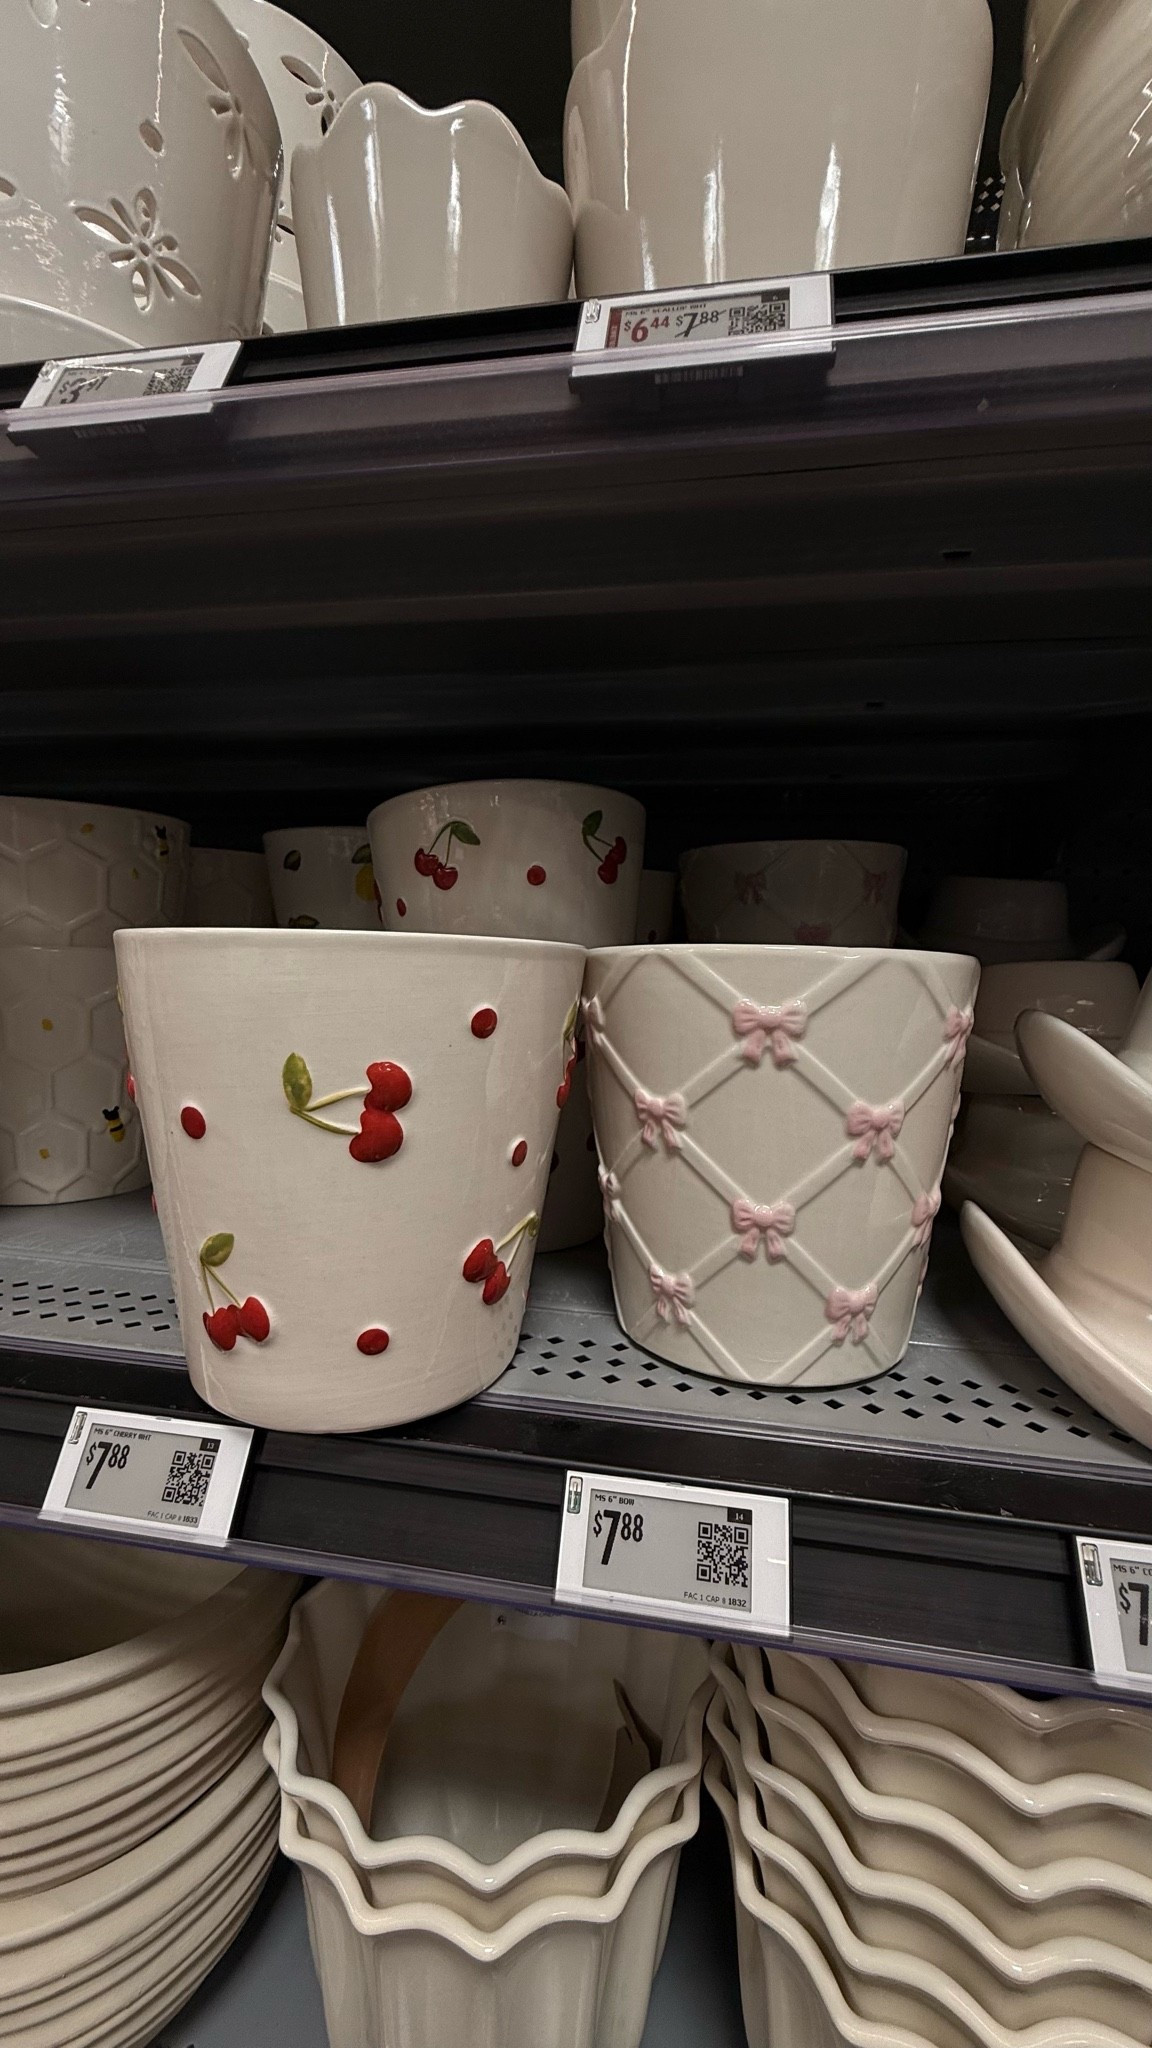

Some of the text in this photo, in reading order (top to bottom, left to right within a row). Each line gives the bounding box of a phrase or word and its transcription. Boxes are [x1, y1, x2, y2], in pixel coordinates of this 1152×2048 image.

[113, 1430, 137, 1439] CHERRY
[206, 1442, 215, 1450] 13
[594, 1494, 606, 1502] MS
[618, 1497, 635, 1506] BOW
[147, 1510, 160, 1518] FAC
[182, 1515, 199, 1524] 1833
[735, 1512, 744, 1521] 14
[1113, 1564, 1127, 1573] MS
[683, 1591, 698, 1600] FAC
[705, 1595, 720, 1603] CAP
[728, 1597, 747, 1608] 1832
